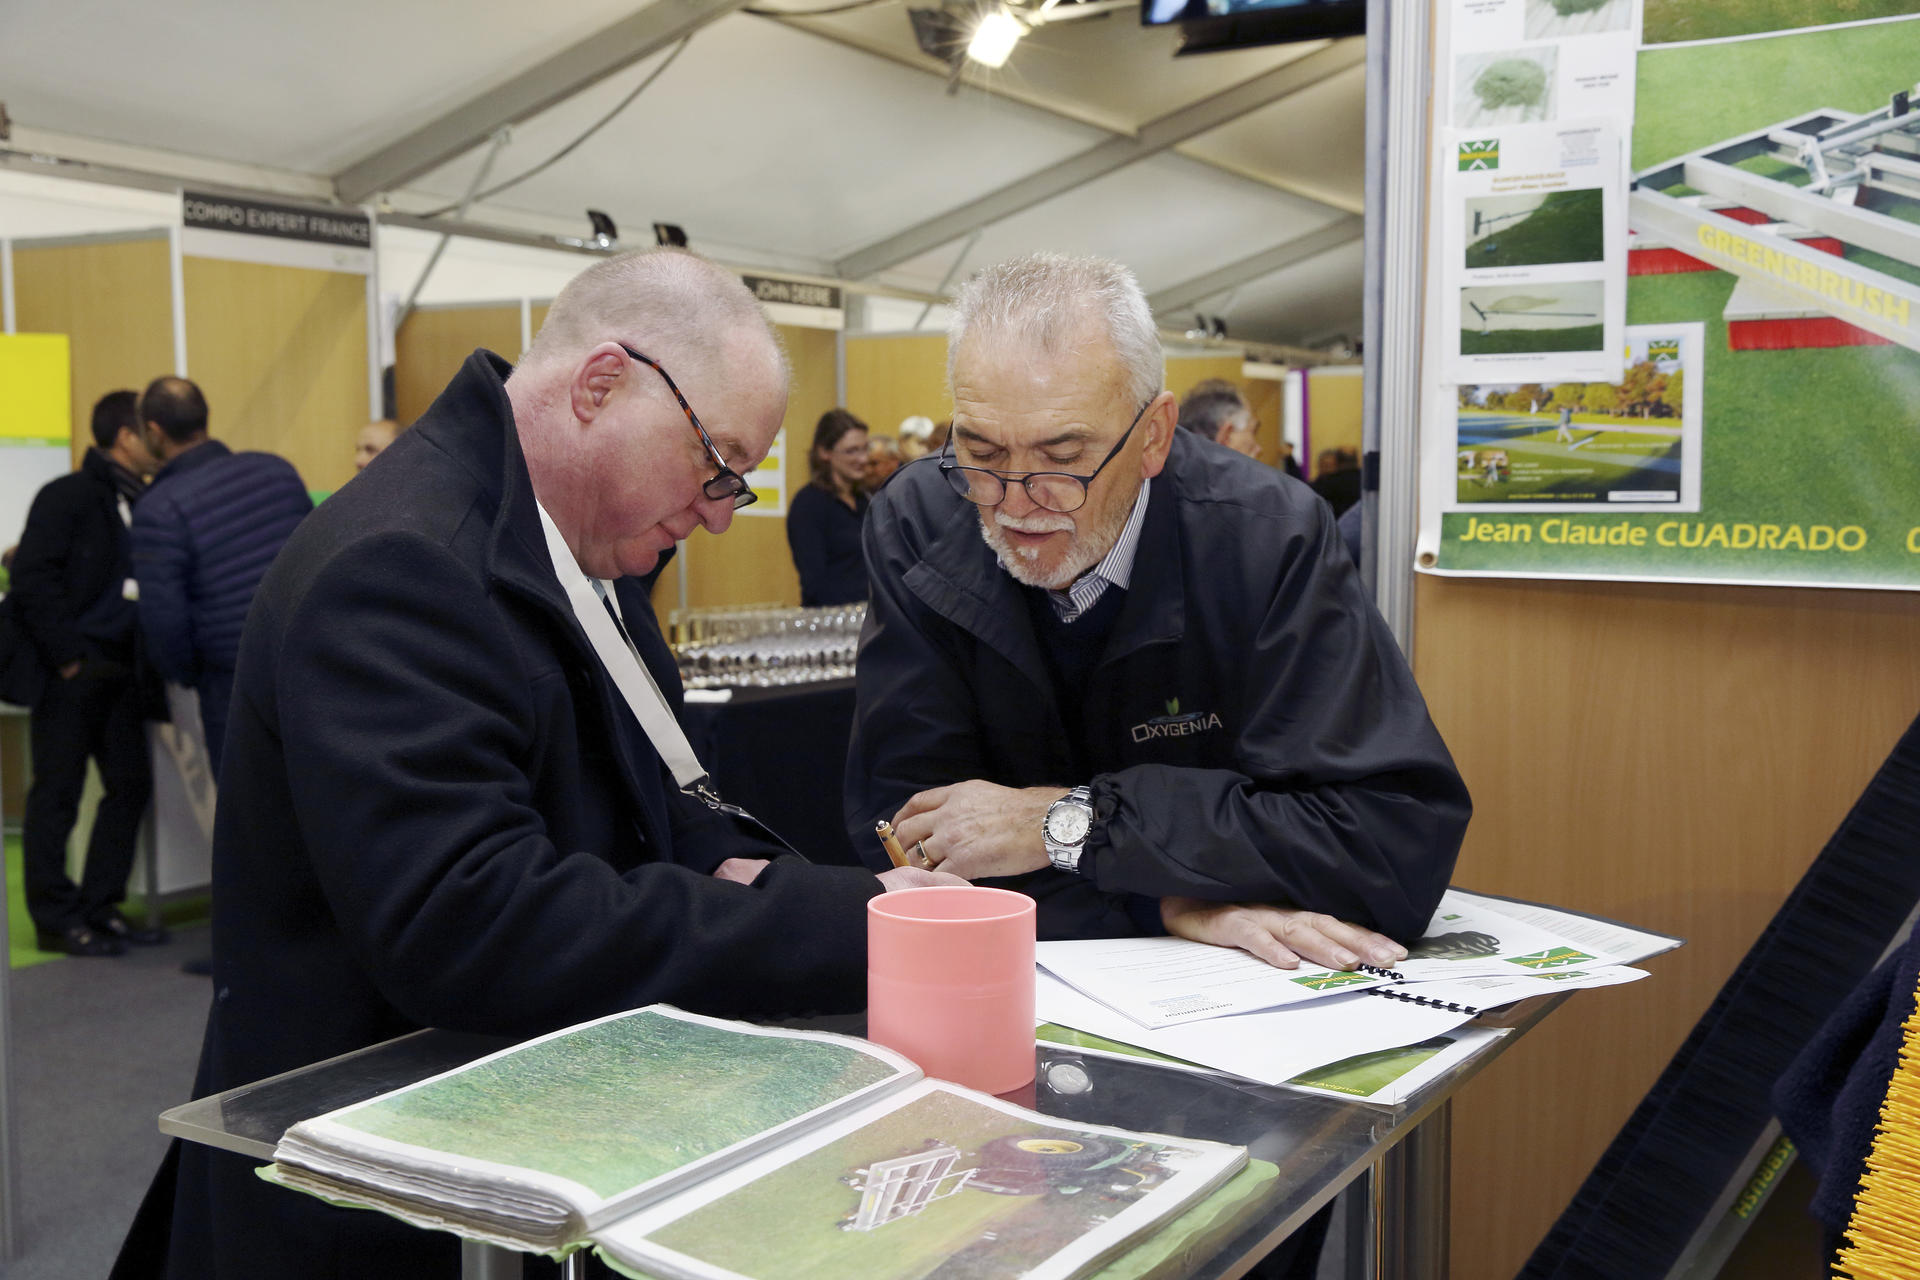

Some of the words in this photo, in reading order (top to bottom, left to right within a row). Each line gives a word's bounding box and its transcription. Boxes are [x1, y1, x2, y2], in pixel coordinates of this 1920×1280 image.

[184, 200, 245, 226] COMPO
[246, 208, 308, 233] EXPERT
[309, 216, 369, 242] FRANCE
[1698, 224, 1910, 326] GREENSBRUSH
[1459, 517, 1532, 543] Jean
[1539, 519, 1648, 546] Claude
[1655, 521, 1868, 551] CUADRADO
